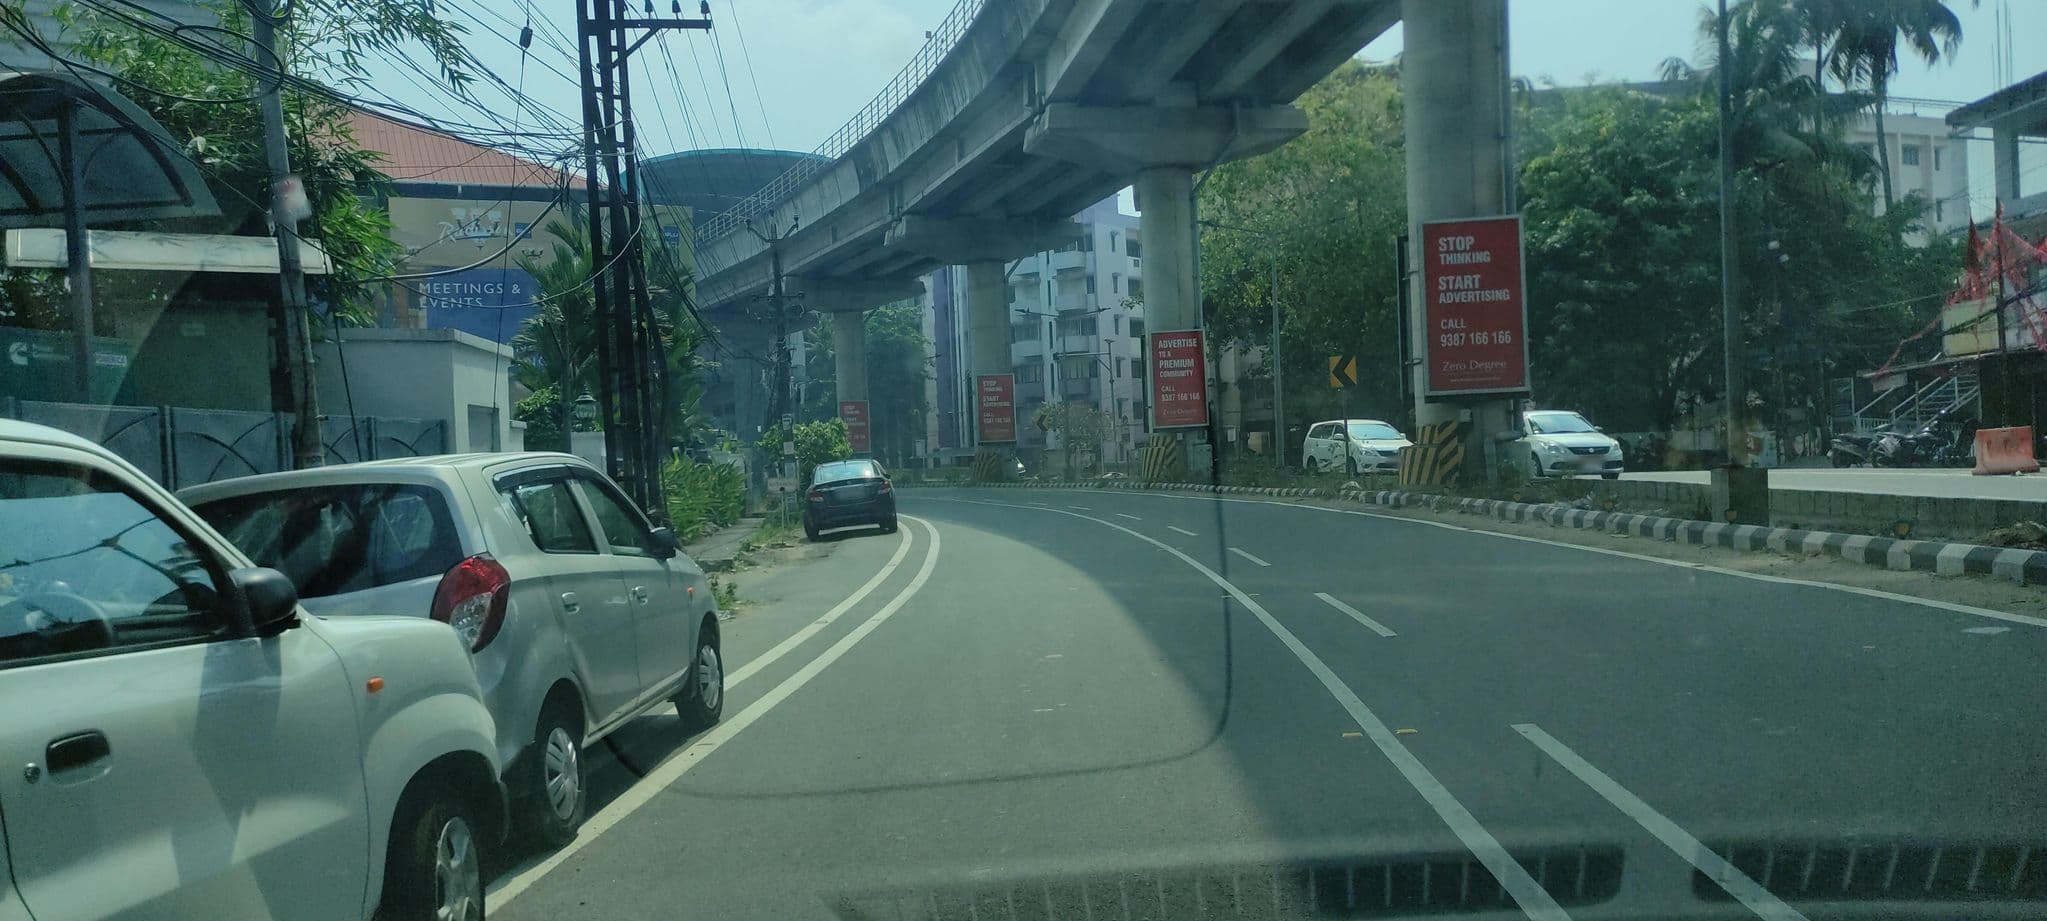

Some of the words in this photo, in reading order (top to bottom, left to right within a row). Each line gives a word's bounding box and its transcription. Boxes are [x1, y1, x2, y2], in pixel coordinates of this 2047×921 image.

[1438, 236, 1475, 251] STOP
[1439, 251, 1491, 265] THINKING
[419, 282, 503, 294] MEETINGS
[511, 283, 521, 294] &
[1438, 274, 1481, 290] START
[1439, 289, 1510, 303] ADVERTISING
[419, 297, 483, 309] EVENTS
[1440, 318, 1467, 330] CALL
[1158, 338, 1197, 348] ADVERTISE
[1440, 332, 1466, 347] 9387
[1469, 332, 1489, 345] 166
[1492, 330, 1512, 344] 166
[1159, 359, 1195, 368] PREMIUM
[1442, 361, 1466, 371] Zero
[1470, 359, 1507, 373] Degree
[1160, 370, 1193, 378] COMMUNITY
